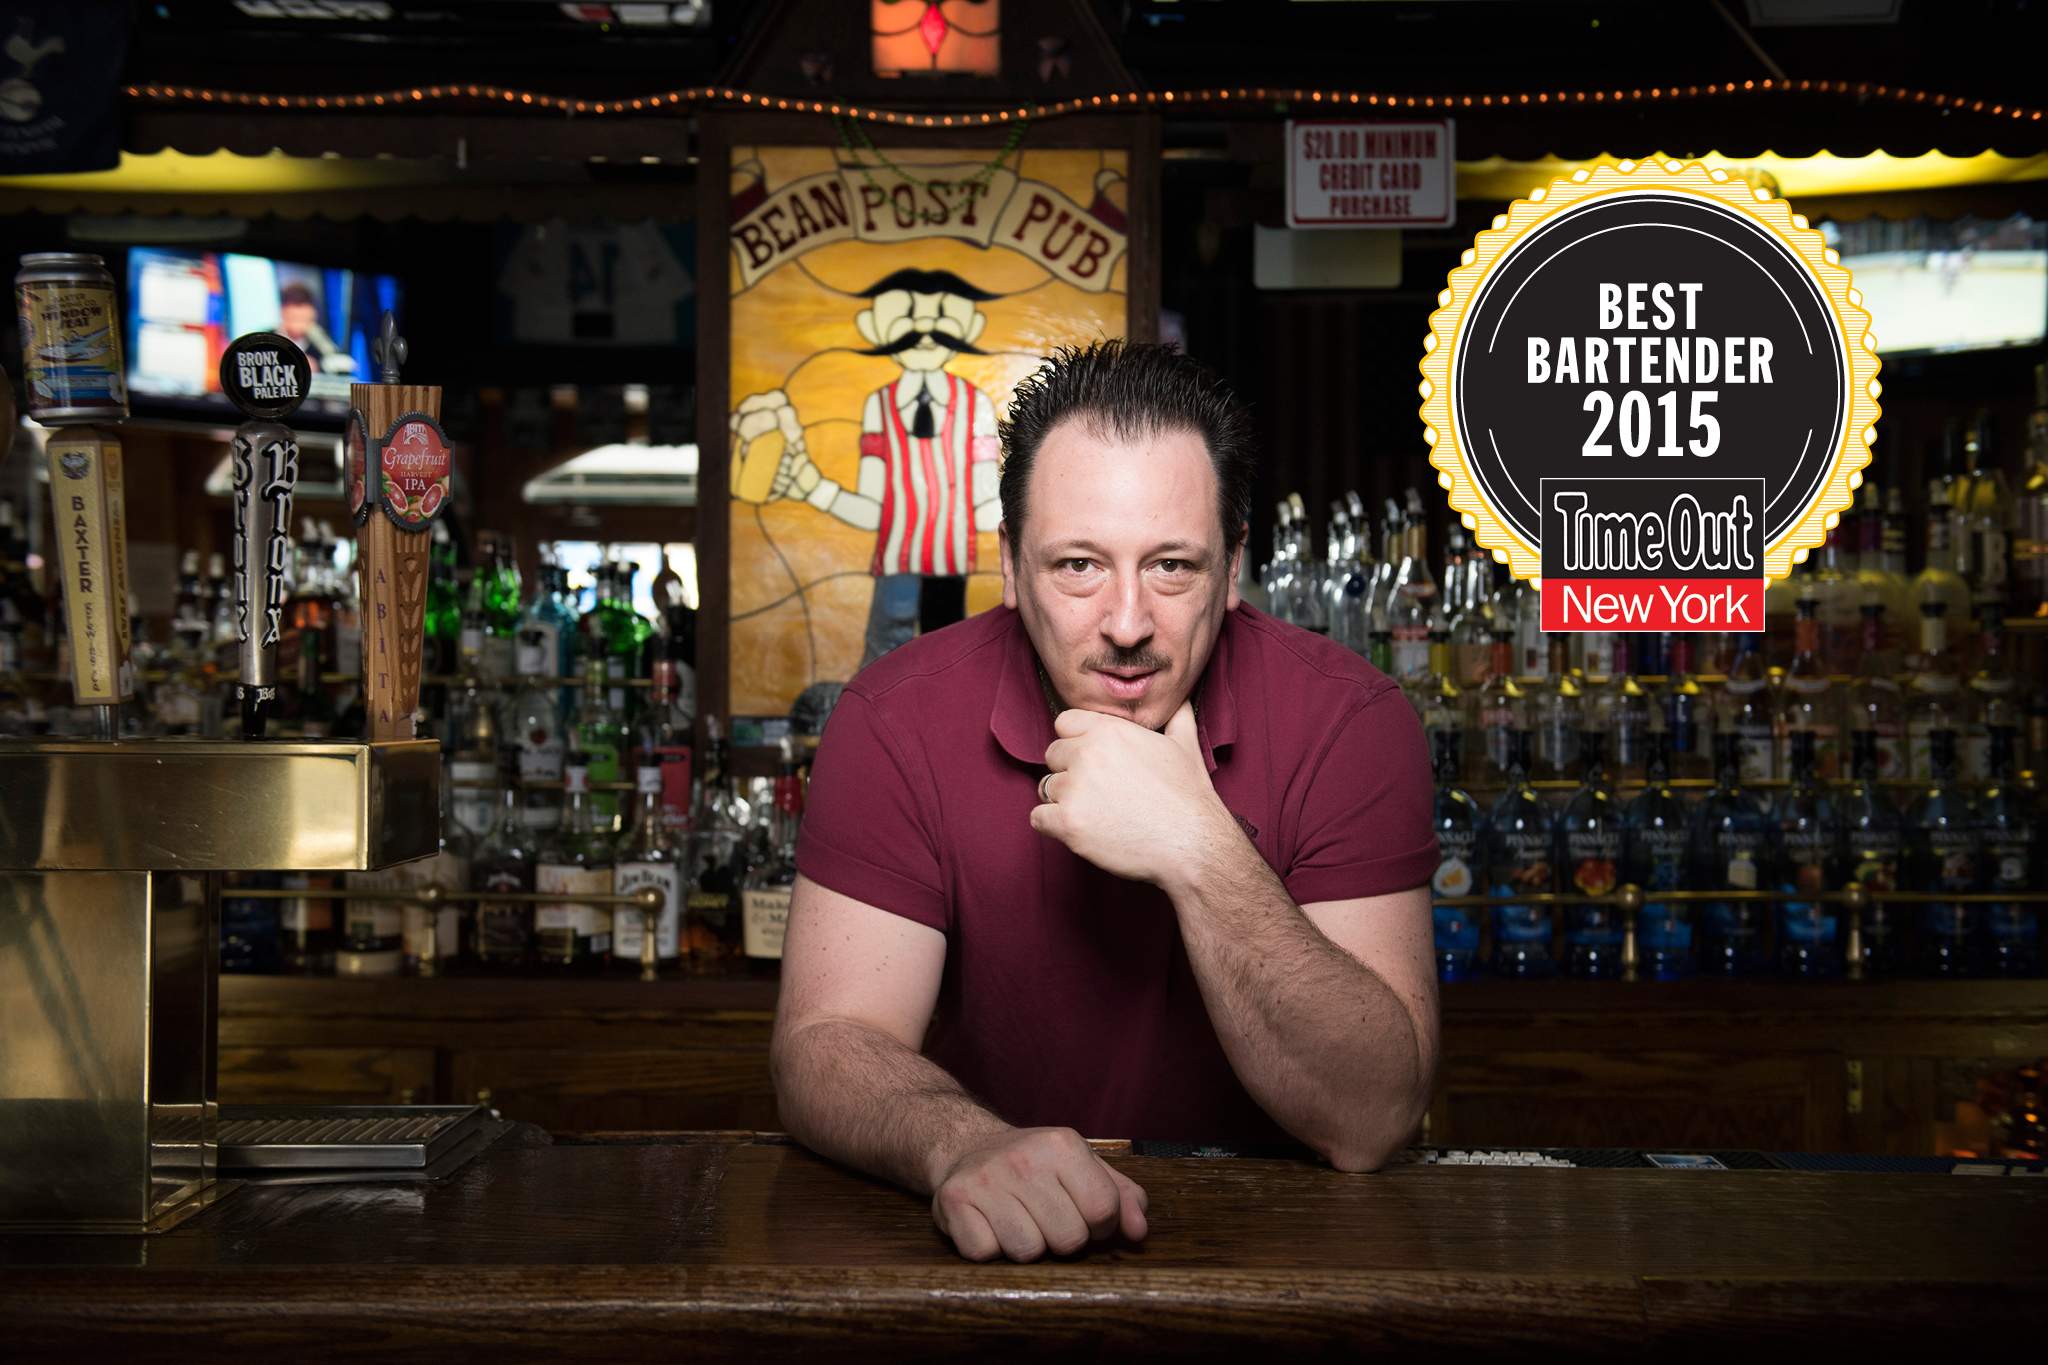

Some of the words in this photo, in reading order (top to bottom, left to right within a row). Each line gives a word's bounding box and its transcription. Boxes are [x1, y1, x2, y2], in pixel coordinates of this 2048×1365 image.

[1364, 130, 1437, 159] MINIMUM
[1319, 162, 1374, 191] CREDIT
[1379, 162, 1422, 191] CARD
[1330, 194, 1411, 216] PURCHASE
[731, 180, 852, 271] BEAN
[858, 179, 989, 232] POST
[1012, 193, 1112, 280] PUB
[236, 350, 280, 367] BRONX
[238, 364, 298, 388] BLACK
[252, 386, 279, 400] PALE
[280, 385, 300, 398] ALE
[402, 423, 428, 438] ABITA
[384, 446, 446, 470] Grapefruit
[404, 478, 427, 491] IPA
[72, 496, 93, 593] BAXTER
[374, 569, 390, 724] ABITA
